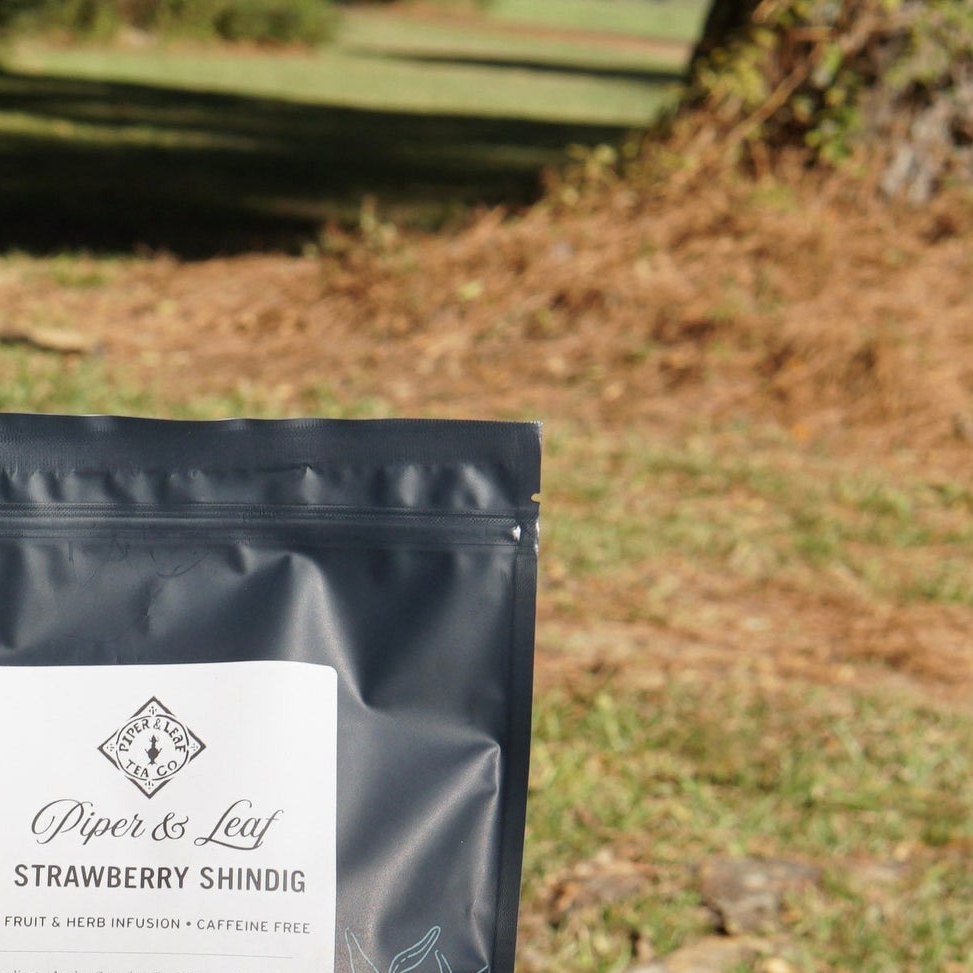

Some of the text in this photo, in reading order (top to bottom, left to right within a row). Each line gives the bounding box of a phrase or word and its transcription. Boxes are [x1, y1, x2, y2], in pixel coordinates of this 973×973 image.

[119, 718, 150, 752] PIPER
[126, 759, 149, 778] TEA
[31, 799, 284, 851] Piper & Leaf
[14, 864, 306, 893] STRAWBERRY SHINDIG
[4, 916, 311, 934] FRUIT & HERB INFUSION CAFFEINE FREE
